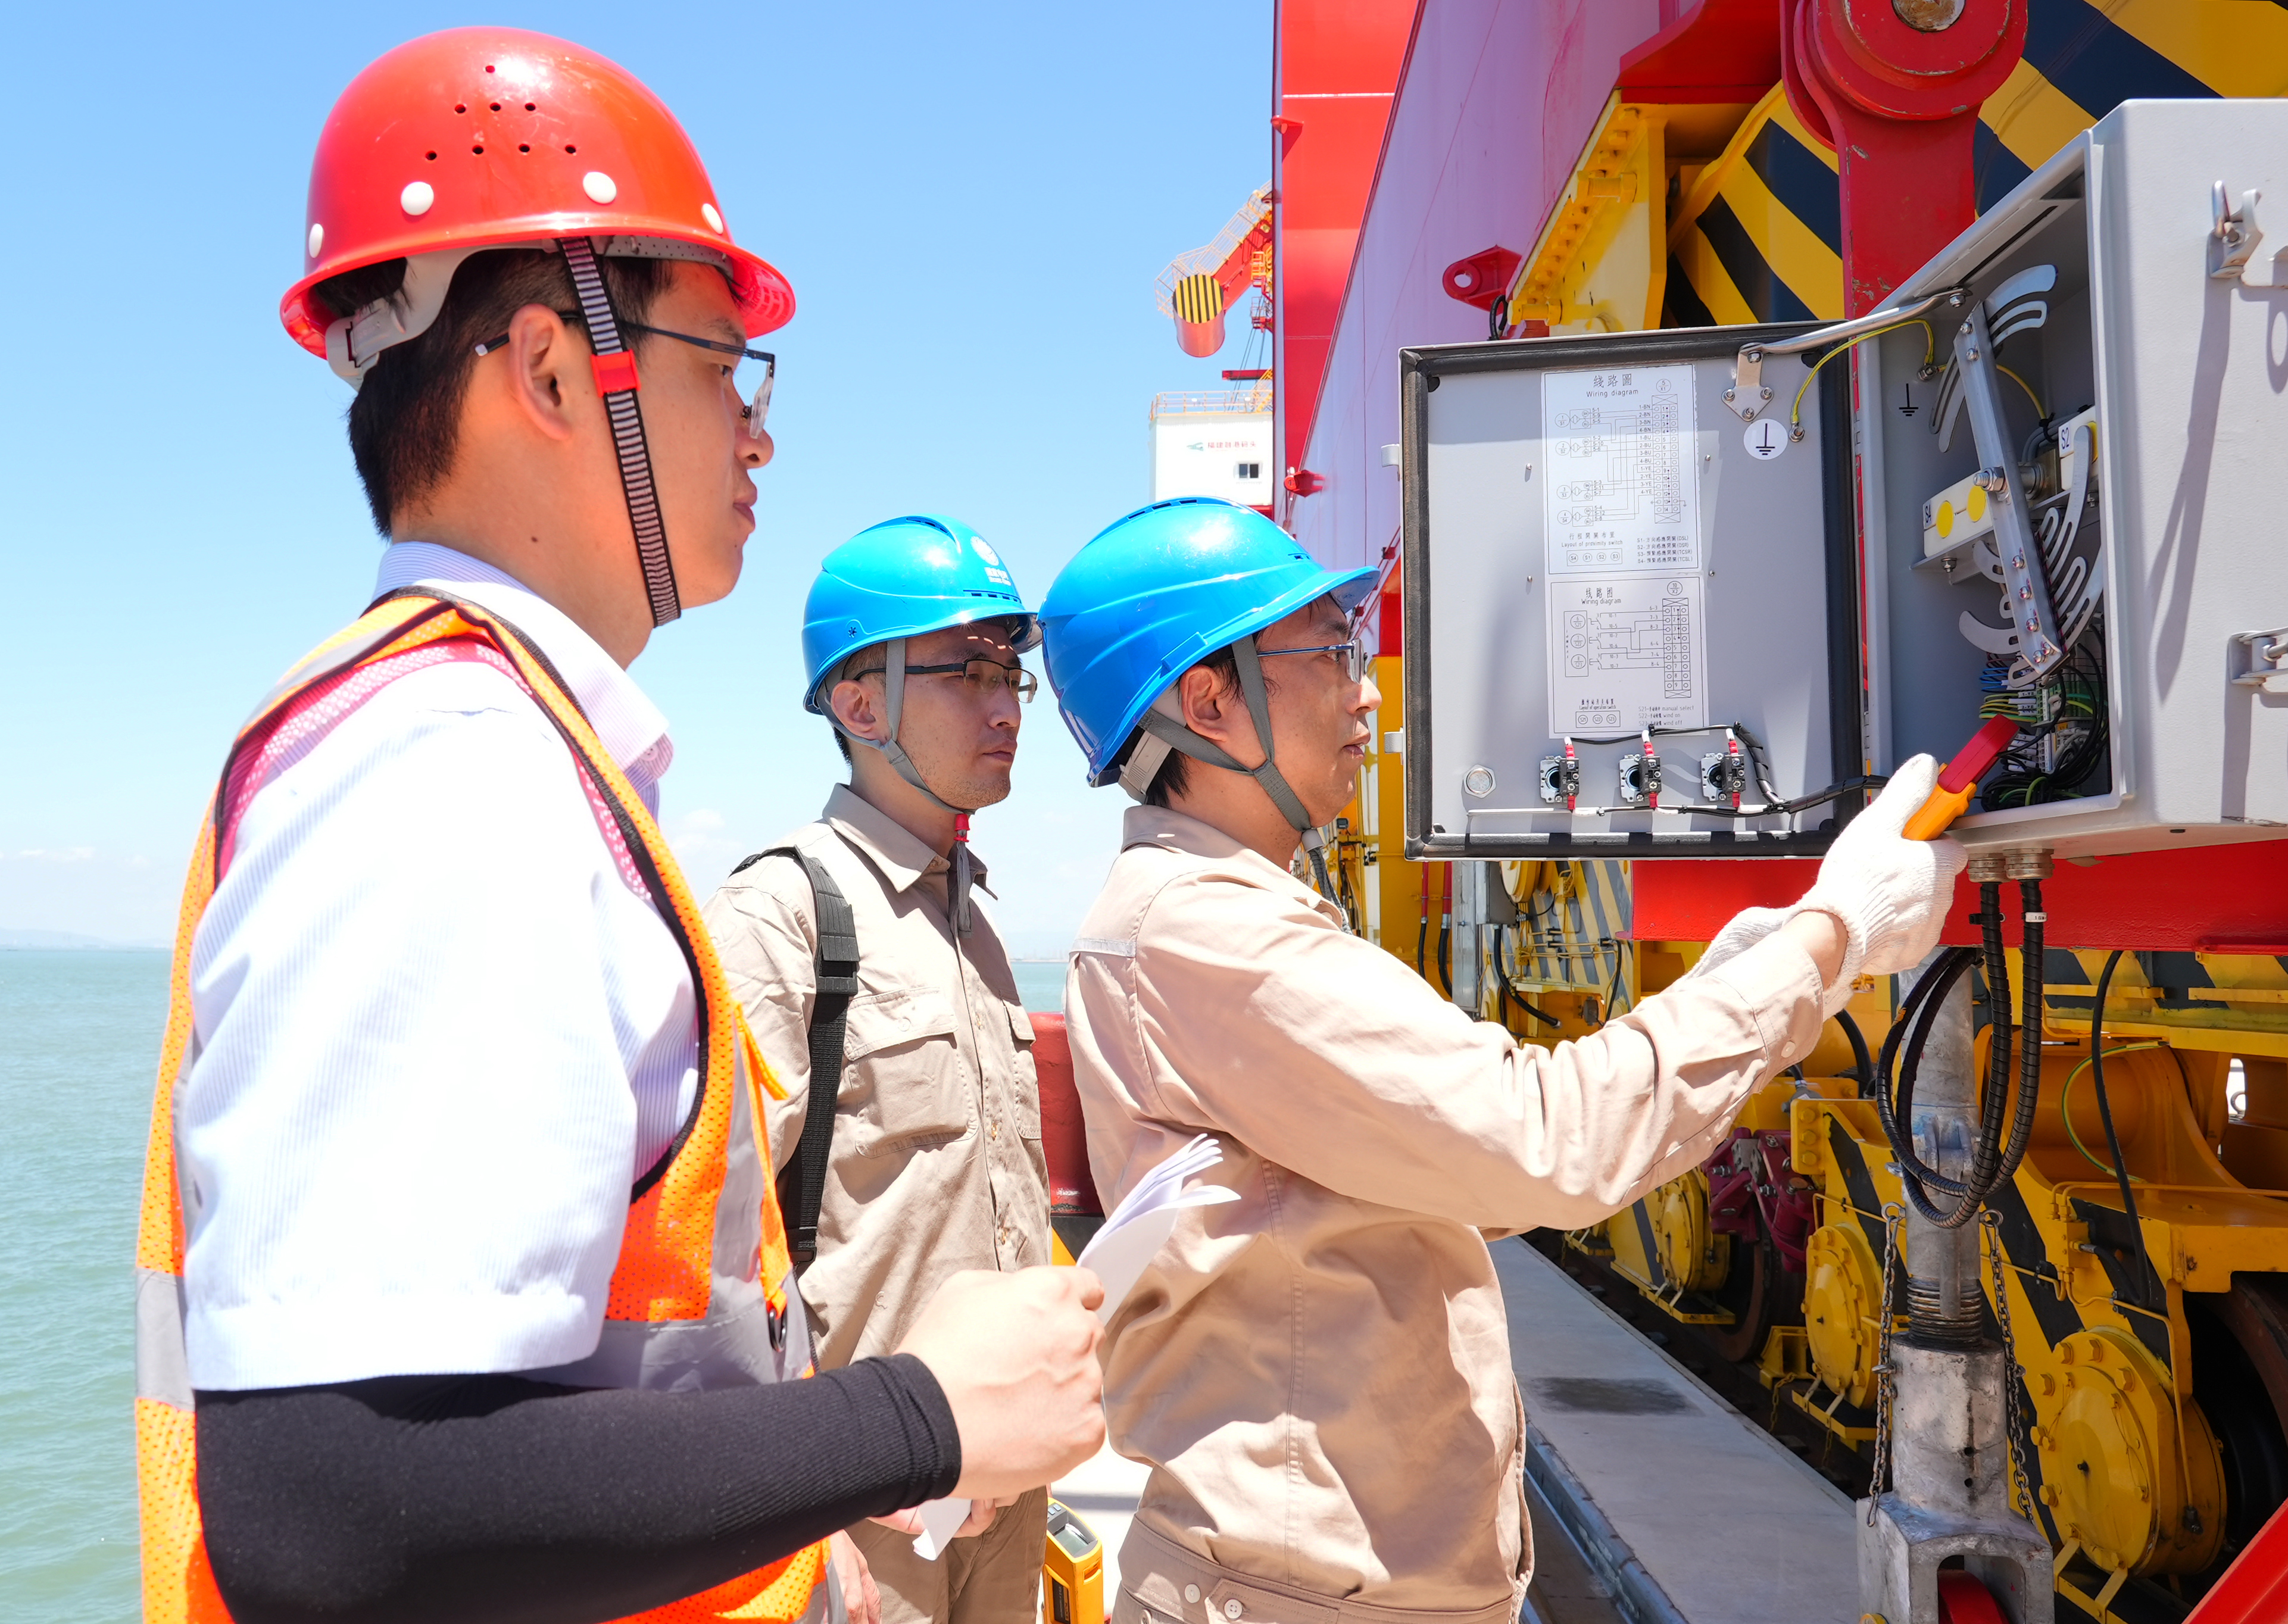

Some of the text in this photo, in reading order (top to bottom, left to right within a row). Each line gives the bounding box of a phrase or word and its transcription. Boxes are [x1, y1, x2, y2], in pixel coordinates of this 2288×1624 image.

[1593, 374, 1632, 388] 線路圖
[1612, 389, 1638, 397] diagram
[2061, 427, 2069, 449] S2
